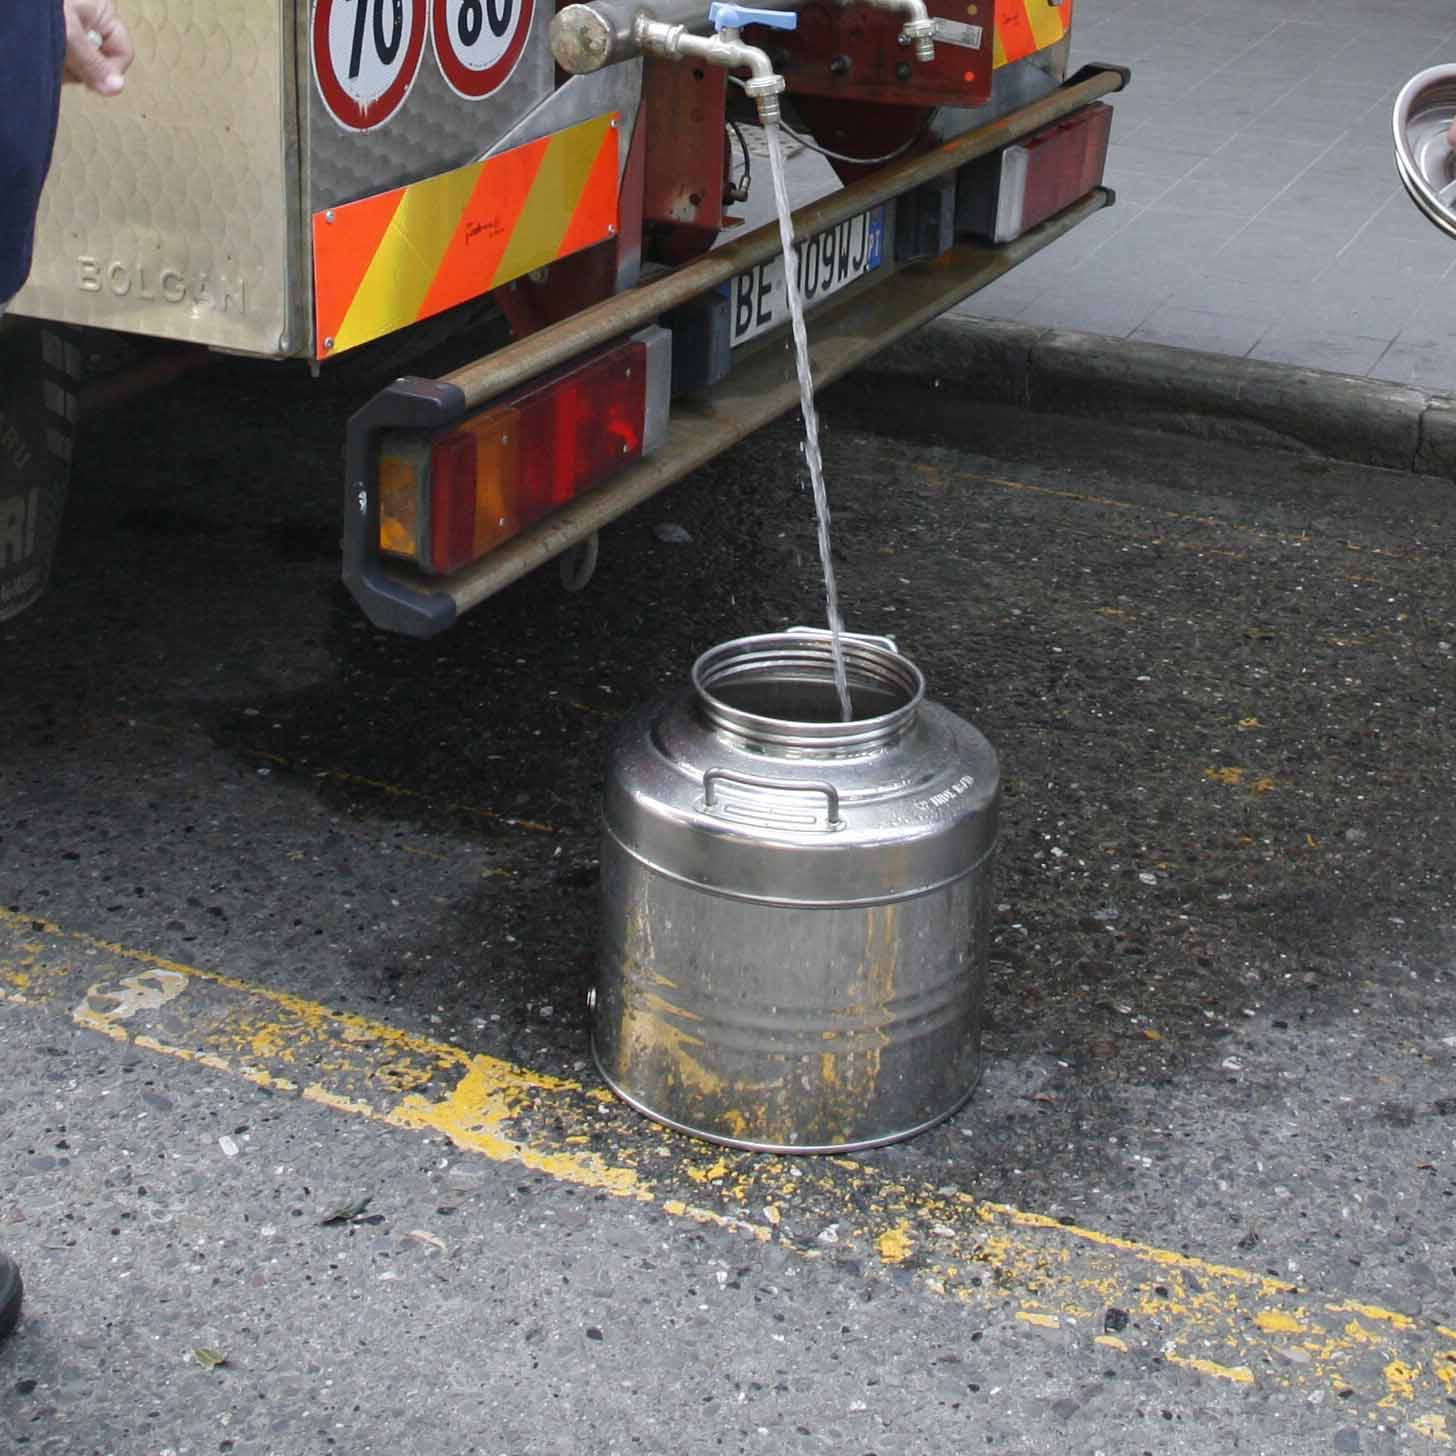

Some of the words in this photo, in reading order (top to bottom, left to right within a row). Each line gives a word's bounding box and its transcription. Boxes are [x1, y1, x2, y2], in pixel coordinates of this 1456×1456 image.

[76, 255, 247, 314] BOLGAN
[736, 263, 771, 337] BE
[786, 213, 866, 310] 09WJ
